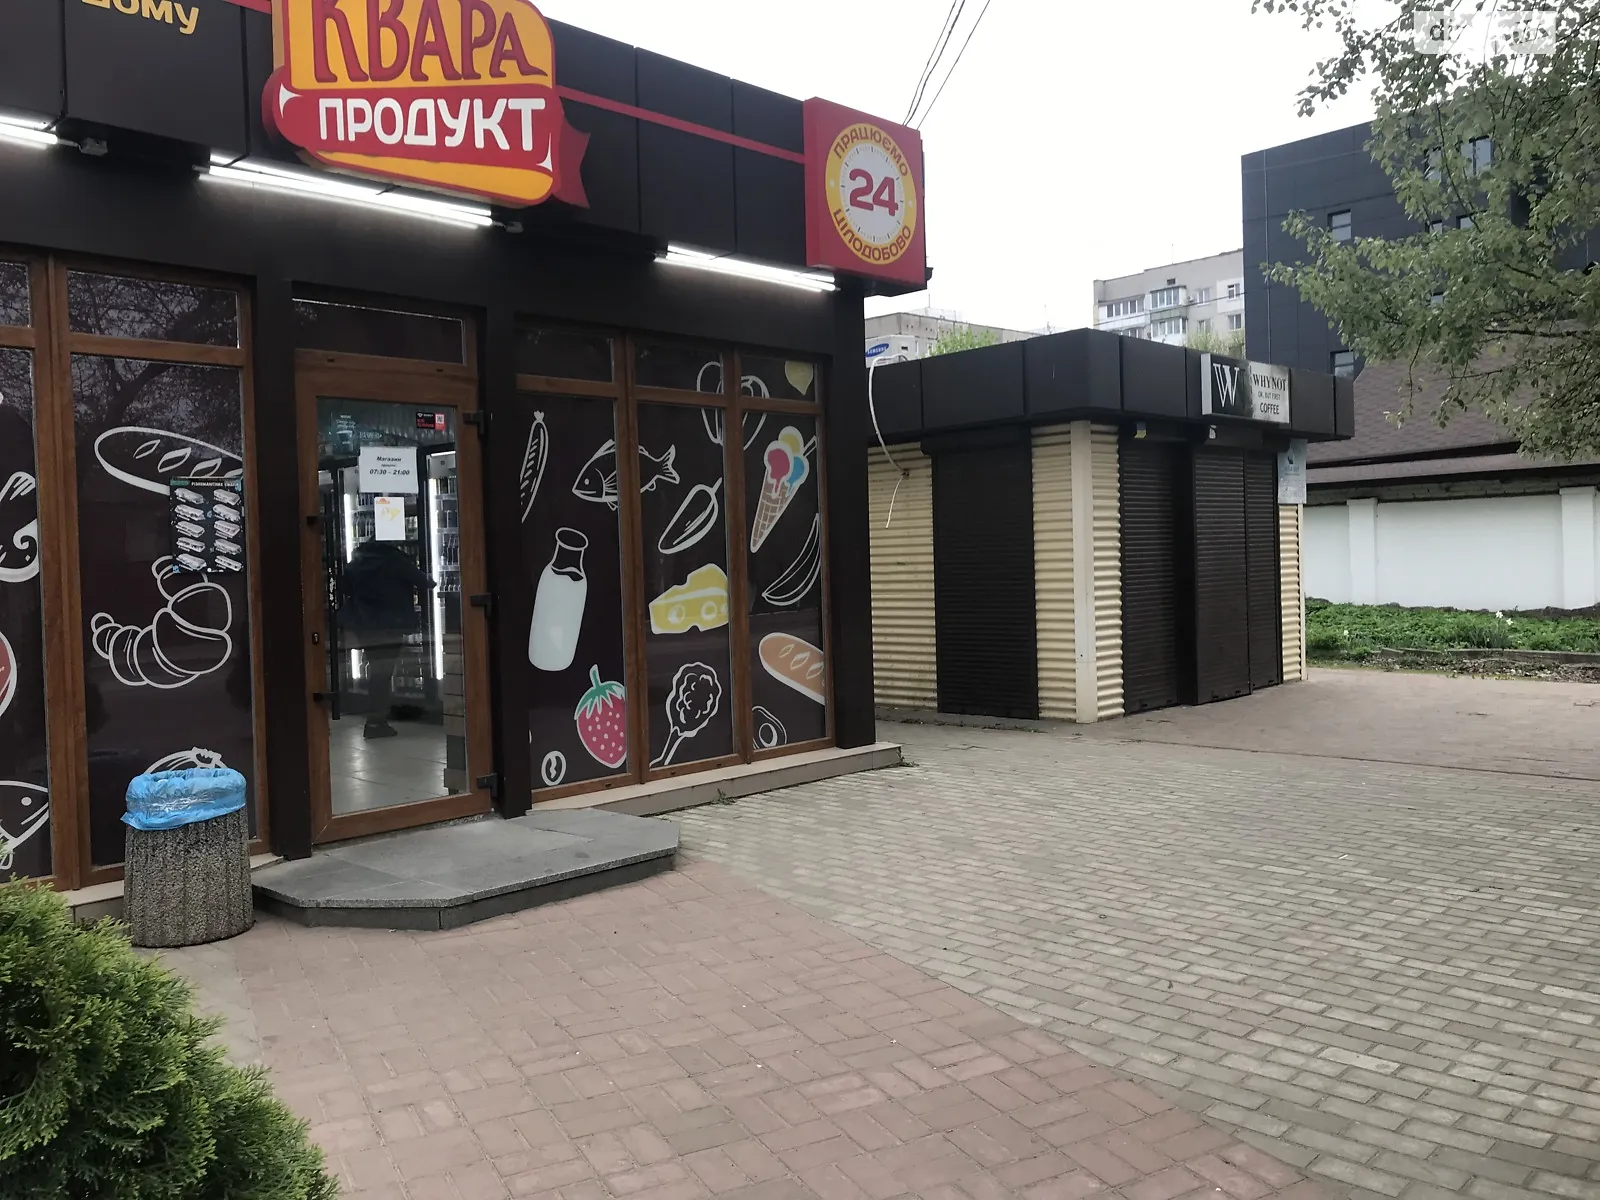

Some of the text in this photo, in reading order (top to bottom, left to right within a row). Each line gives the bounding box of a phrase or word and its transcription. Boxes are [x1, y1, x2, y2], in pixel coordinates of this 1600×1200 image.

[311, 0, 548, 83] КВАРА
[318, 96, 546, 153] ПРОДУКТ
[833, 126, 908, 177] ПРАЦЮЄМО
[849, 168, 899, 216] 24
[833, 208, 911, 261] ЦІЛОДОБОВО
[1212, 363, 1240, 408] W
[1259, 402, 1280, 415] COFFEE
